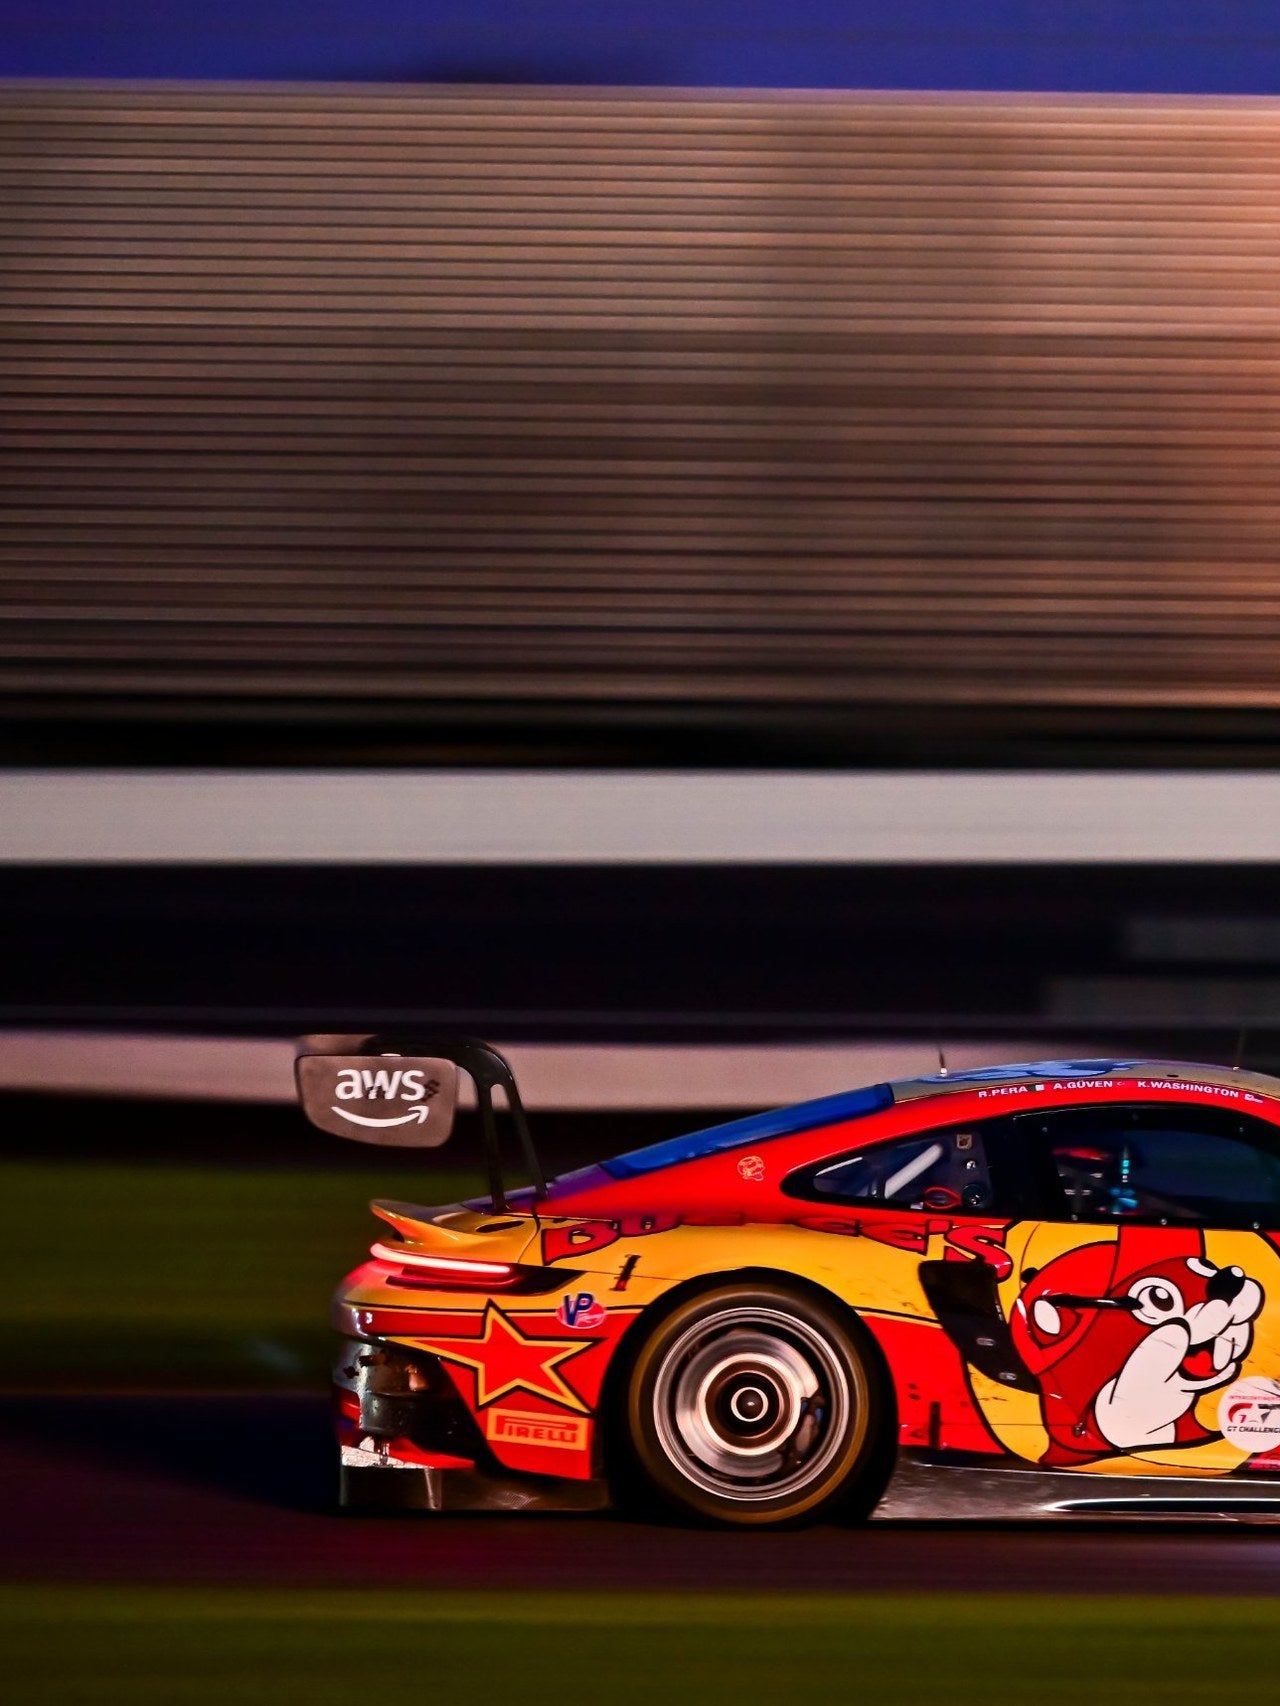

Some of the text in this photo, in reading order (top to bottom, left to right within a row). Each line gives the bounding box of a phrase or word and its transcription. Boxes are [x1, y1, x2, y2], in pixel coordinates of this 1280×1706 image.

[335, 1069, 426, 1101] aws
[978, 1086, 1028, 1098] R.PERA
[1137, 1080, 1239, 1098] K.WASHINGTON
[564, 1293, 594, 1327] VP
[495, 1415, 578, 1444] PIRELLI
